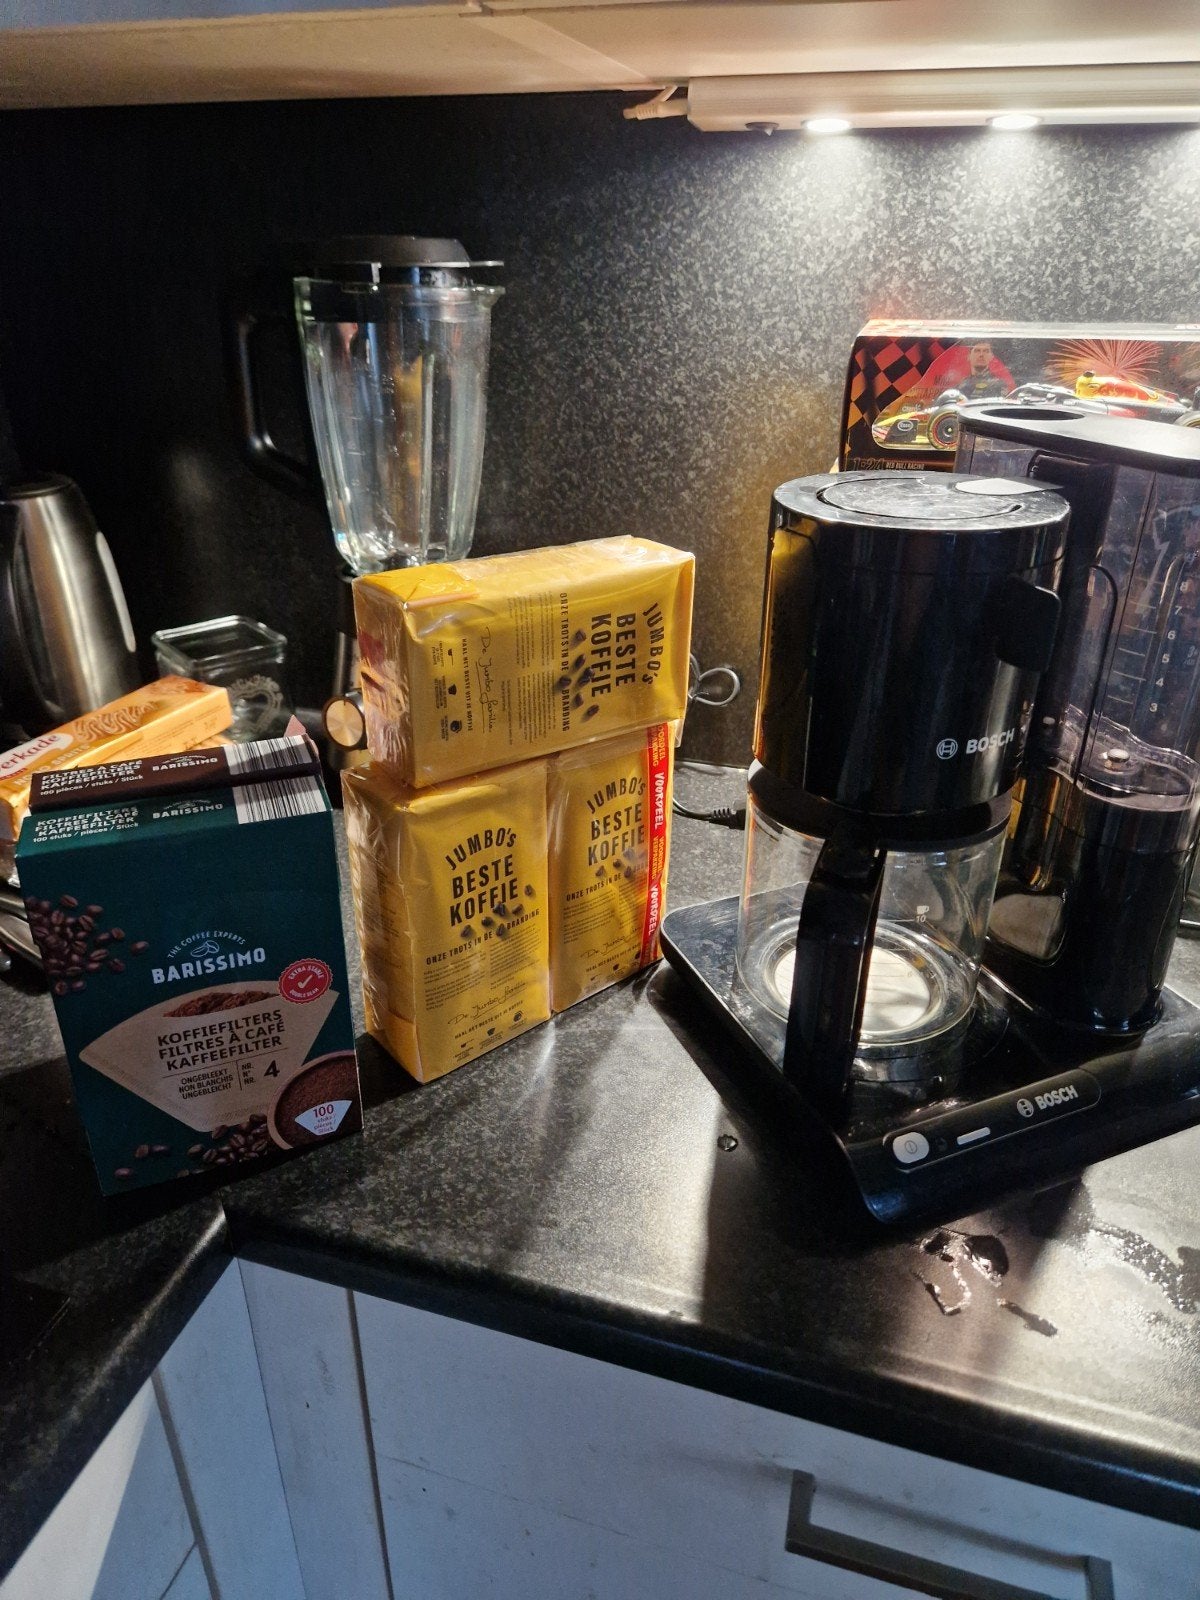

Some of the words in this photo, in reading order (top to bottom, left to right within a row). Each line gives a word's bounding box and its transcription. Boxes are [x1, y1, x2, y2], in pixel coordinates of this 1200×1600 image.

[1180, 581, 1188, 592] 8
[560, 592, 568, 616] ONZE
[1174, 606, 1183, 616] 7
[560, 618, 569, 646] TROTS
[1167, 630, 1176, 640] 6
[561, 648, 569, 658] IN
[591, 613, 612, 697] KOFFIE
[615, 613, 636, 687] BESTE
[1162, 653, 1170, 663] 5
[561, 661, 569, 671] DE
[1156, 678, 1164, 687] 4
[561, 689, 570, 732] BRANDING
[1150, 703, 1158, 713] 3
[966, 727, 1015, 755] BOSCH
[1, 733, 57, 771] erkade
[42, 768, 94, 781] FILTRES
[152, 757, 218, 771] BARISSIMO
[41, 765, 141, 786] KOFFIEFILTERS
[41, 770, 134, 791] KAFFEEFILTER
[91, 779, 113, 787] stuks
[121, 774, 143, 783] Stück
[153, 803, 224, 819] BARISSIMO
[654, 772, 665, 830] VOORDEEL
[35, 820, 89, 832] FILTRES
[37, 806, 138, 827] KOFFIEFILTERS
[38, 816, 134, 837] KAFFEEFILTER
[591, 802, 642, 841] BESTE
[50, 832, 72, 841] stuks
[116, 821, 139, 831] Stück
[588, 825, 645, 867] KOFFIE
[651, 836, 659, 880] VERPAKKING
[452, 854, 514, 899] BESTE
[566, 890, 584, 902] ONZE
[585, 882, 604, 896] TROTS
[614, 872, 622, 882] DE
[450, 878, 519, 927] KOFFIE
[648, 885, 659, 936] VOORDEEL
[167, 944, 181, 958] THE
[181, 930, 210, 947] COFFEE
[214, 930, 246, 945] EXPERTS
[426, 952, 448, 966] ONZE
[449, 941, 472, 957] TROTS
[474, 936, 482, 946] IN
[484, 931, 493, 941] DE
[506, 908, 540, 930] BRANDING
[151, 947, 266, 985] BARISSIMO
[288, 965, 306, 980] EXTRA
[157, 1009, 282, 1047] KOFFIEFILTERS
[159, 1036, 224, 1060] FILTRES
[229, 1029, 241, 1044] À
[246, 1019, 285, 1040] CAFÉ
[166, 1035, 282, 1071] KAFFEEFILTER
[241, 1062, 254, 1071] NR.
[264, 1060, 280, 1078] 4
[179, 1083, 196, 1094] NON
[197, 1074, 234, 1091] BLANCHIS
[182, 1082, 232, 1100] UNGEBLEICHT
[1035, 1084, 1079, 1110] BOSCH
[313, 1104, 334, 1118] 100
